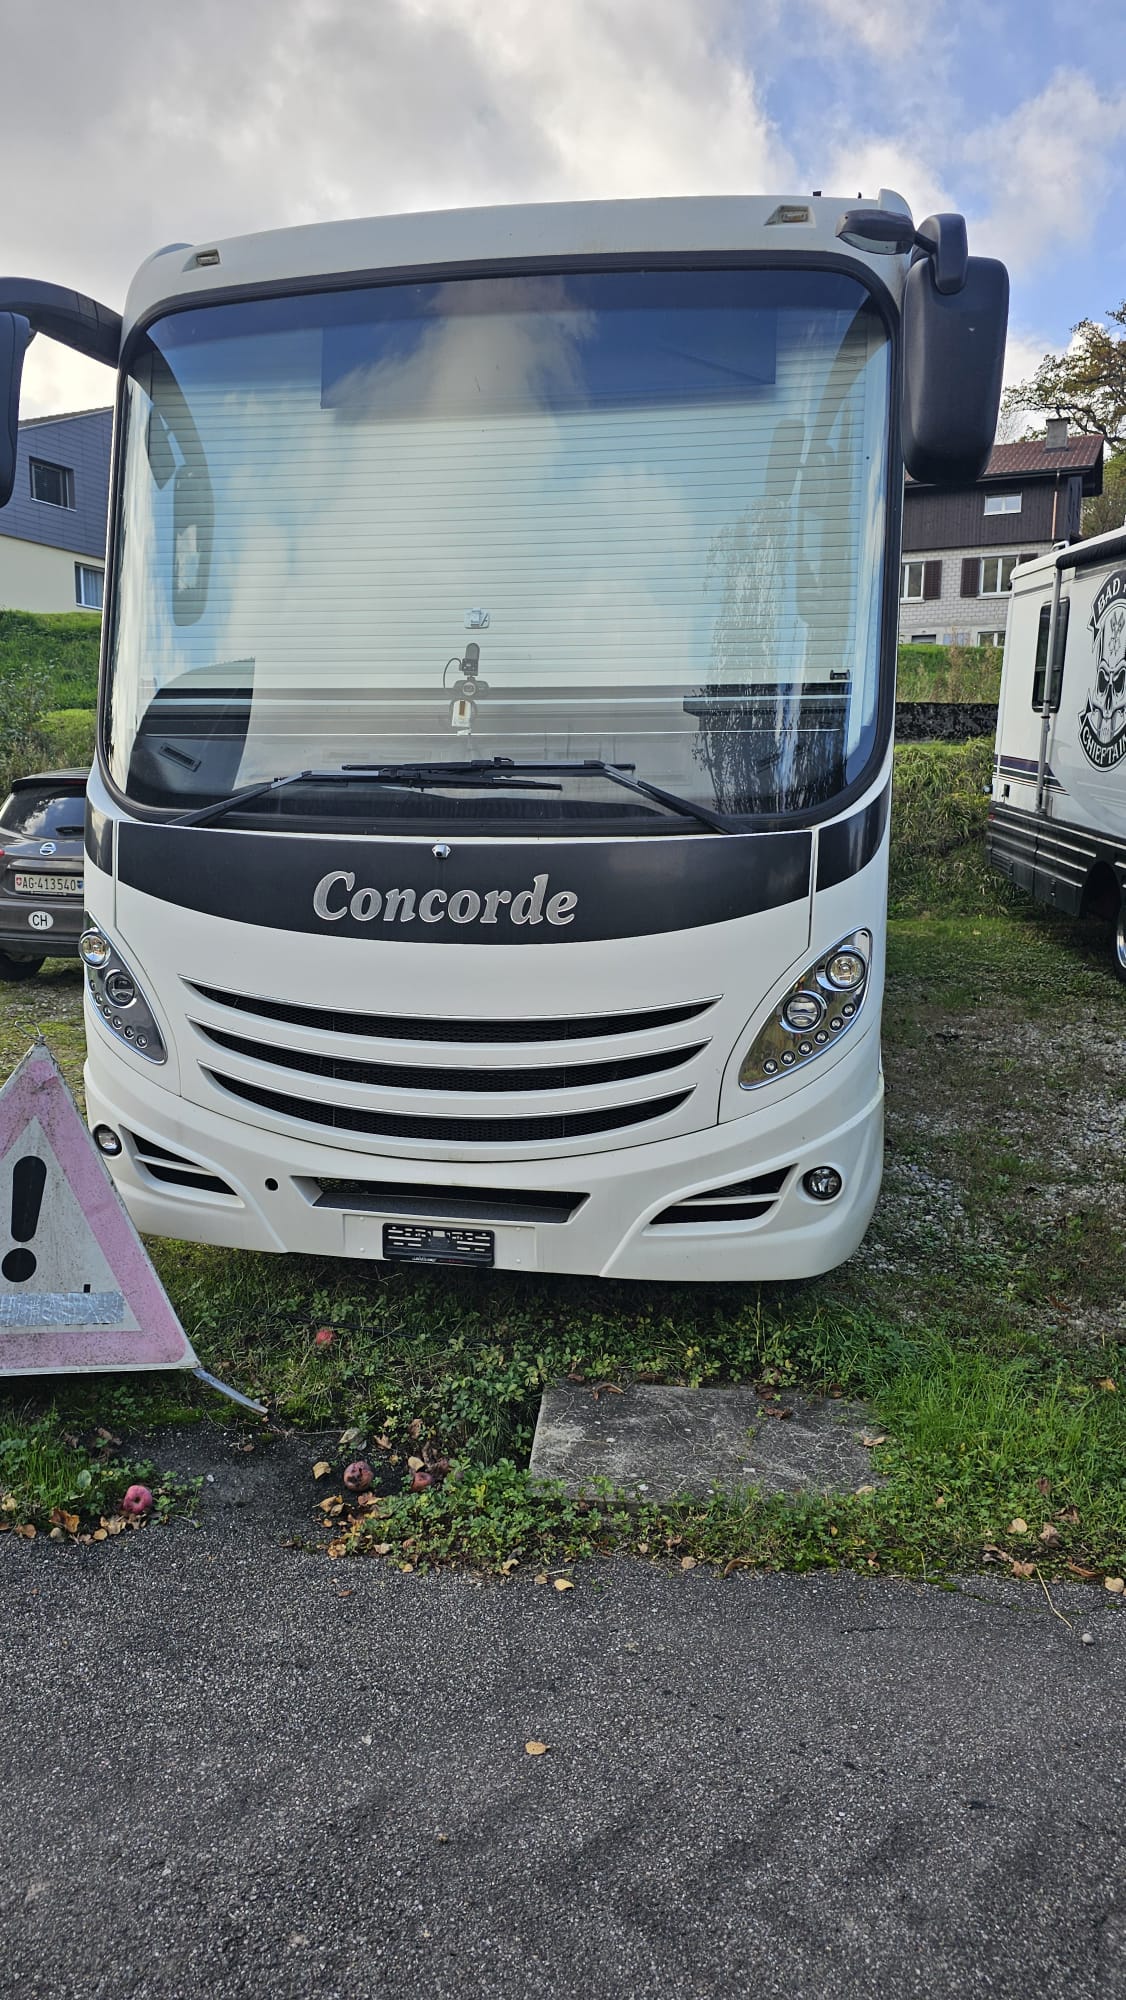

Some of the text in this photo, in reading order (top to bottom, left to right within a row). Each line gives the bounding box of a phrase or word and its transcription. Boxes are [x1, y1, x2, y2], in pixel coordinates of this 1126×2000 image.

[1098, 577, 1121, 615] BAD
[313, 870, 578, 926] Concorde
[32, 914, 48, 927] CH
